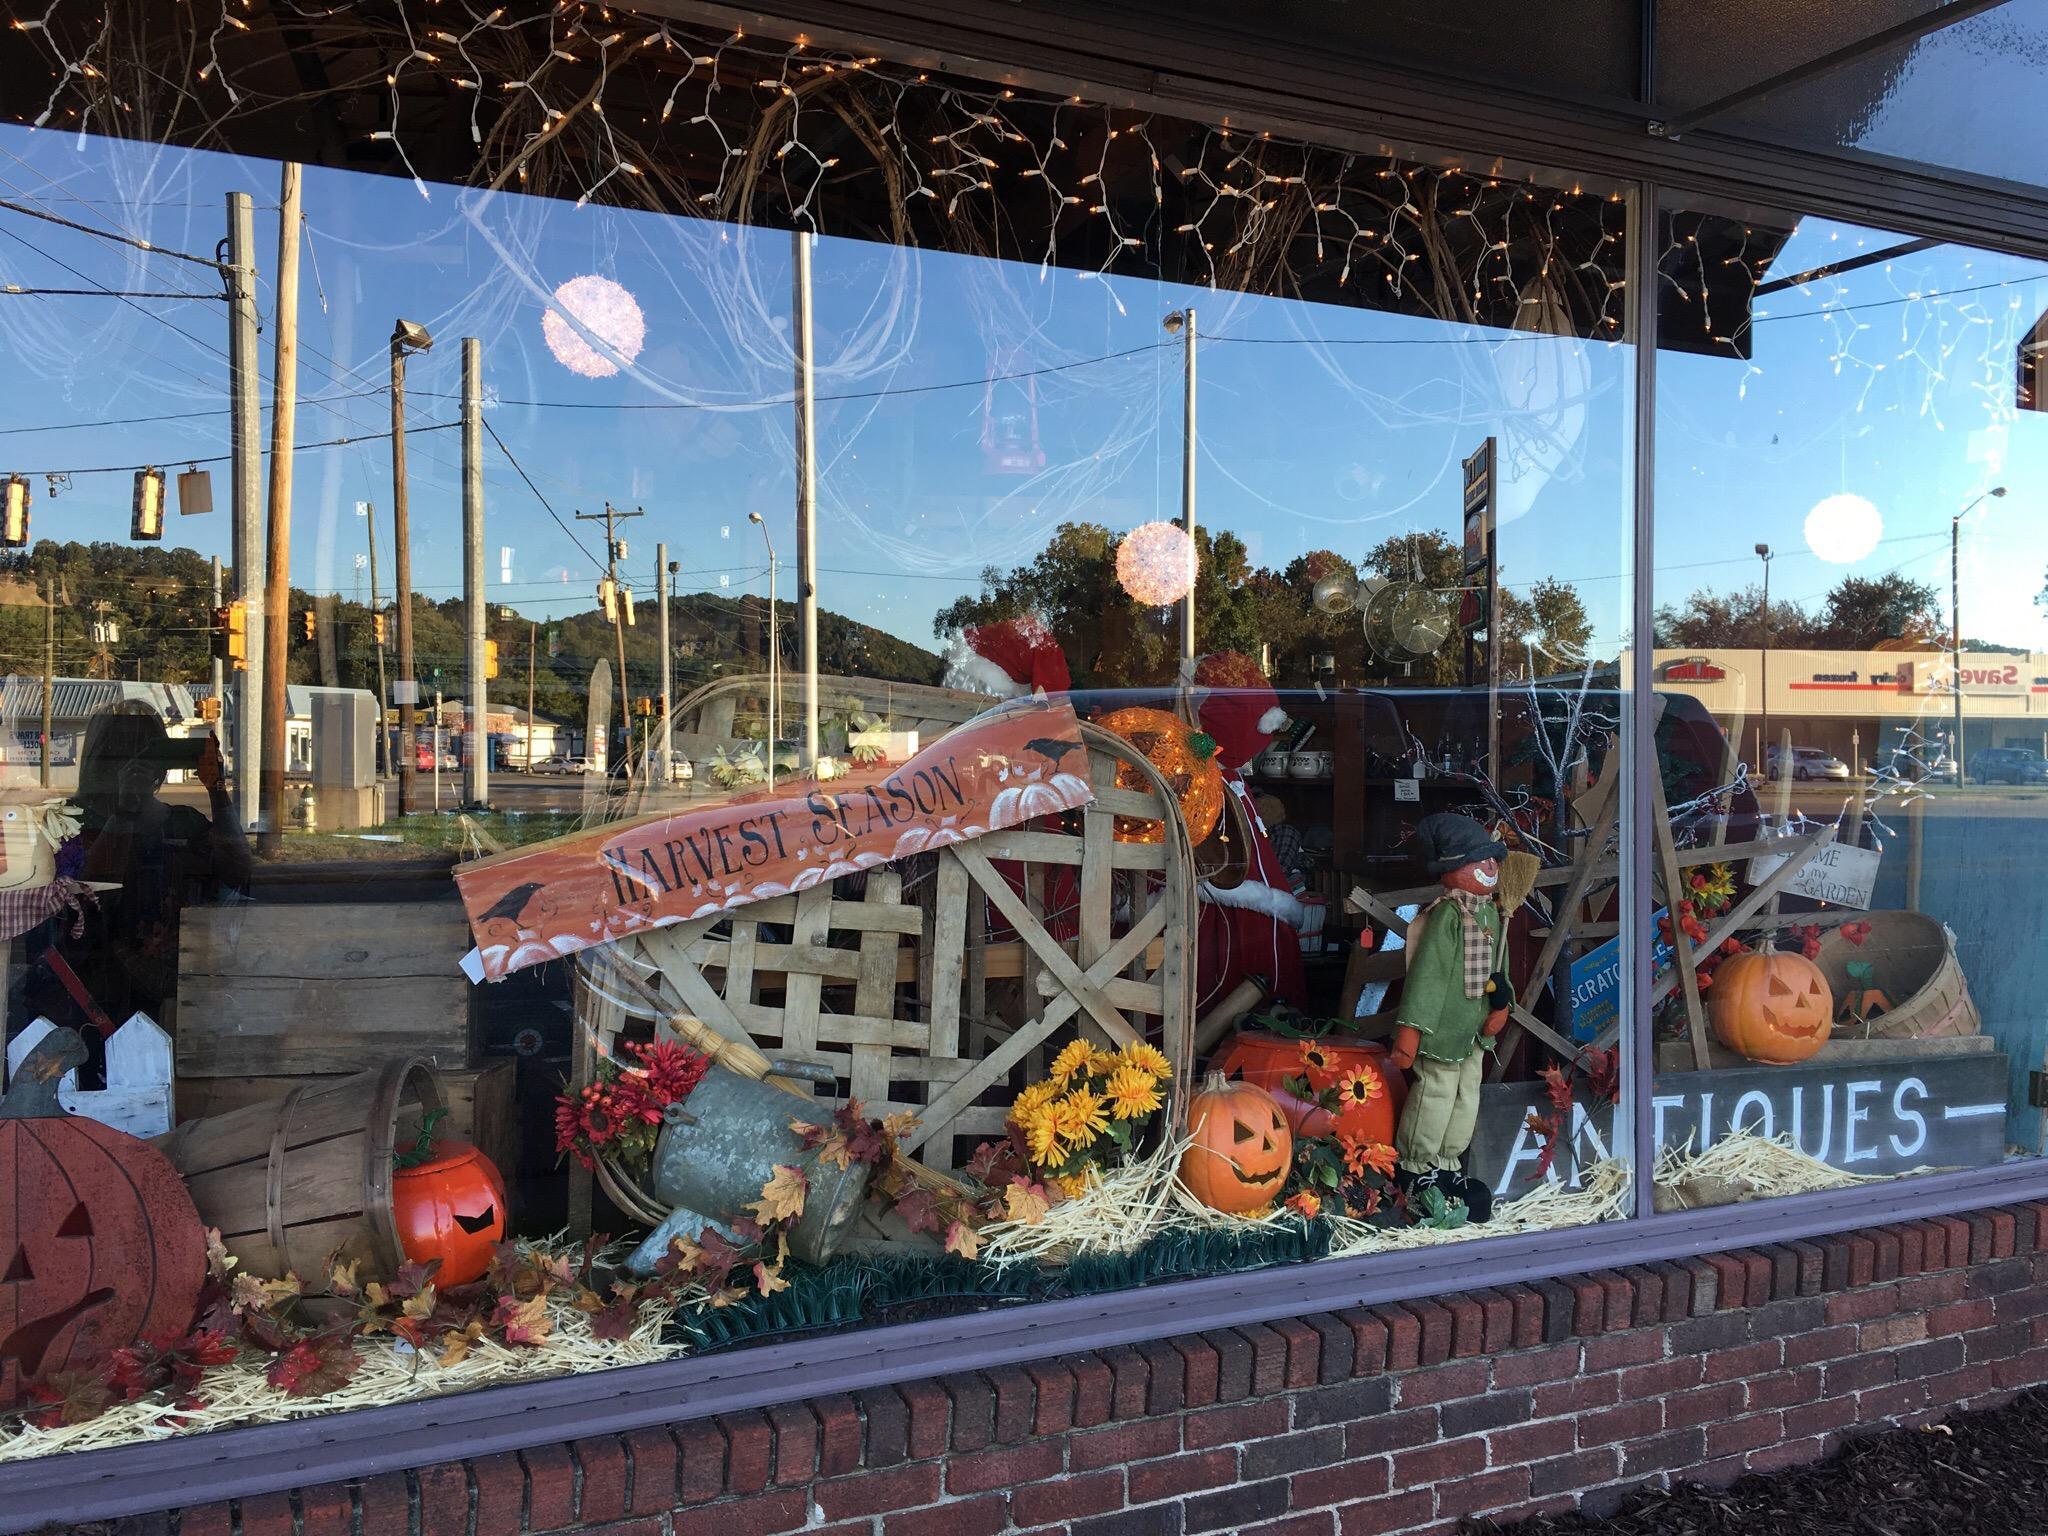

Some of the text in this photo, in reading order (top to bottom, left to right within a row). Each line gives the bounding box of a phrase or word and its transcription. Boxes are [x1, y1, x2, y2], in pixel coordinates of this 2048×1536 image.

[603, 756, 966, 906] HARVEST SEASON
[1803, 879, 1868, 906] GARDEN
[1495, 1076, 1928, 1196] ANTIQUES
